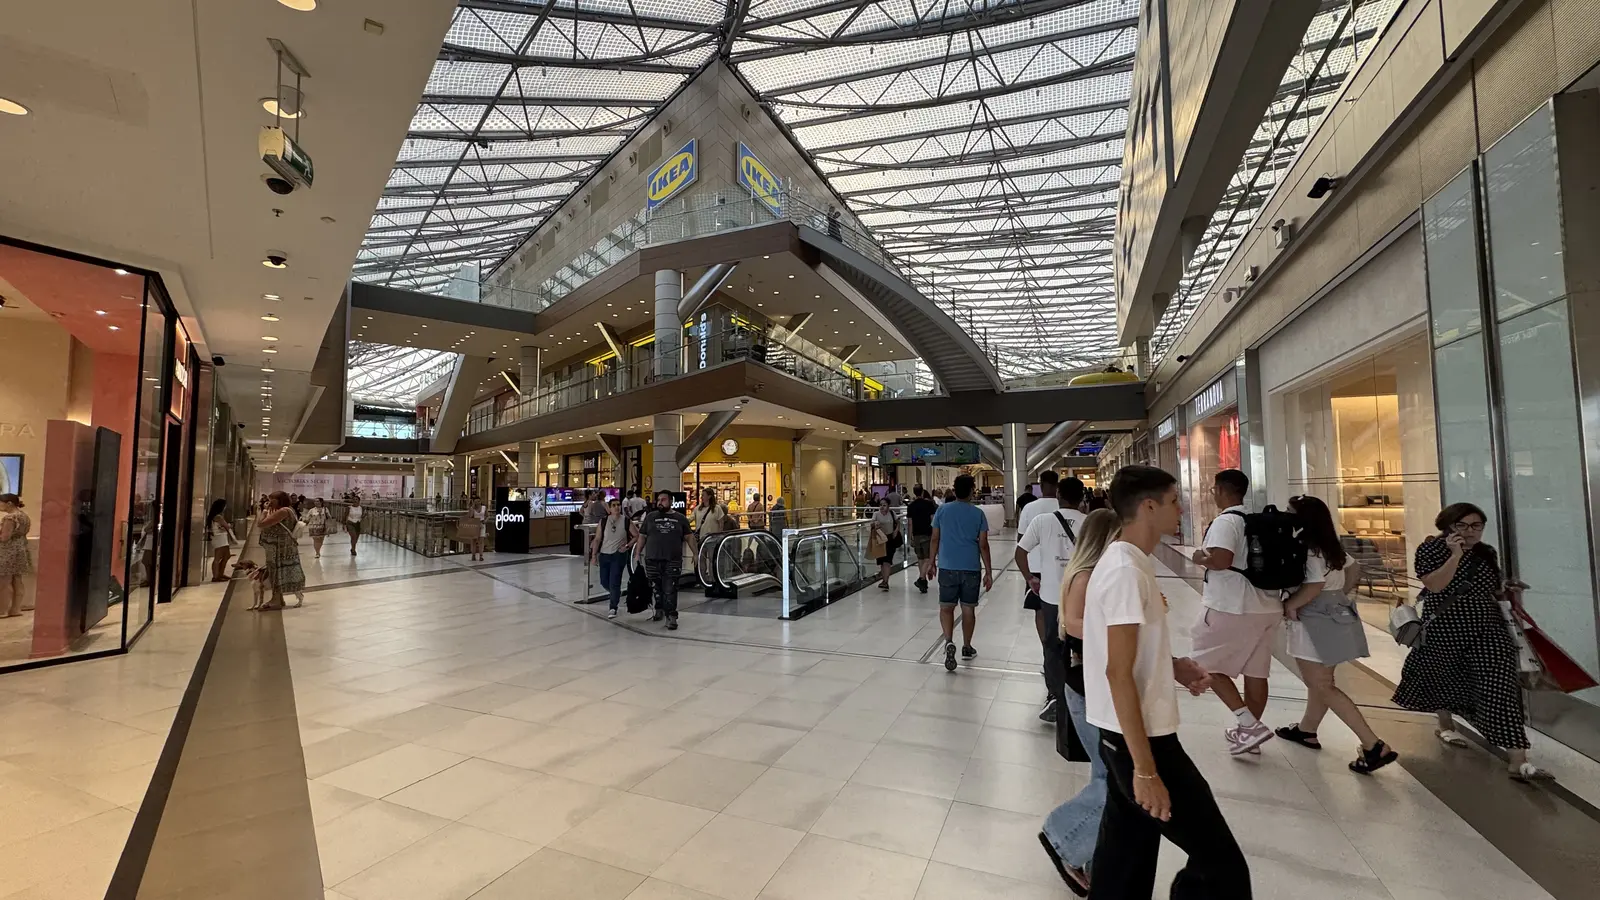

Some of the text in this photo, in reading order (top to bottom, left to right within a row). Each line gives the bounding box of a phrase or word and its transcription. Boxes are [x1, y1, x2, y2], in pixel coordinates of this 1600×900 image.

[652, 157, 689, 196] IKEA
[746, 159, 780, 199] IKEA
[496, 506, 524, 531] ploom
[671, 496, 685, 509] oom
